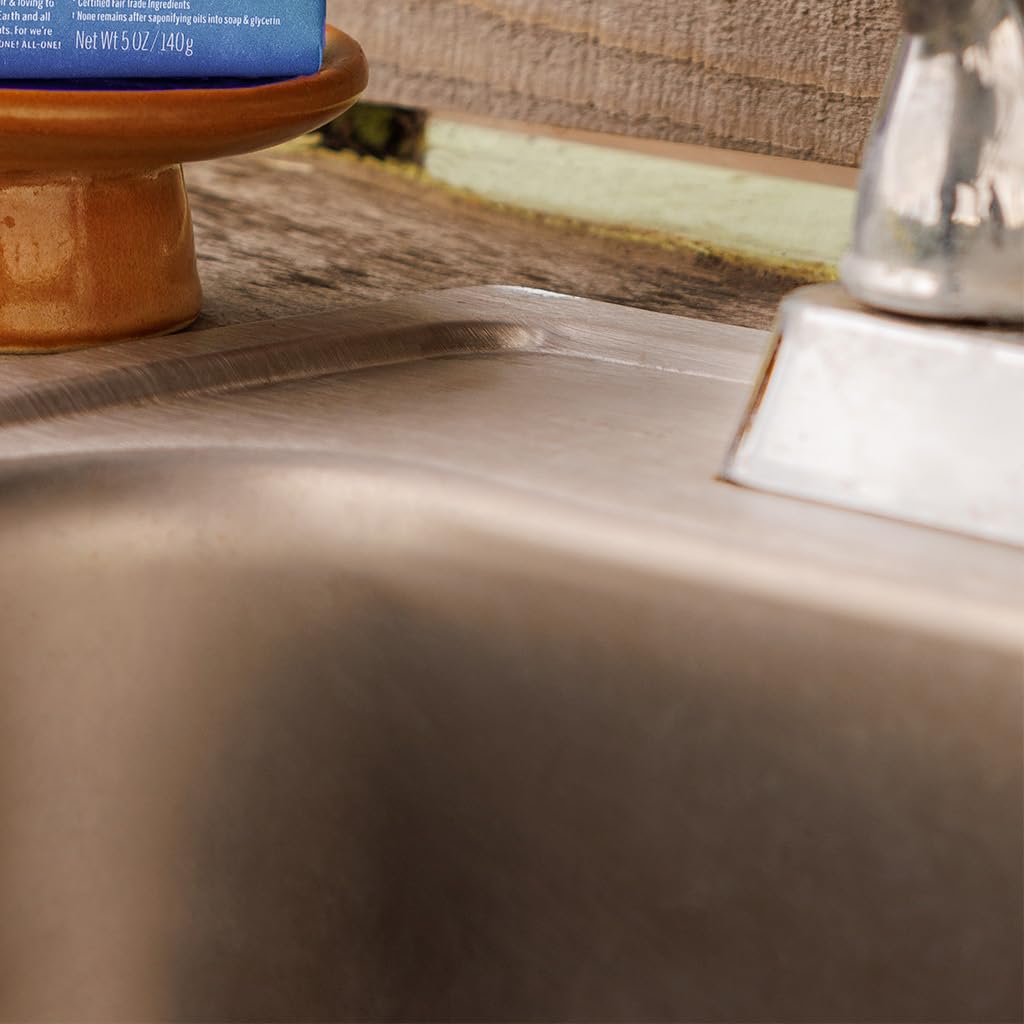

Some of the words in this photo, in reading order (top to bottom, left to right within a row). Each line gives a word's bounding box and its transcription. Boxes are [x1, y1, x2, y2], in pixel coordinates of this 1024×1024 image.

[127, 0, 147, 9] Trade
[147, 0, 191, 11] Ingredients
[22, 11, 38, 21] and
[39, 11, 51, 22] all
[77, 11, 96, 22] None
[97, 12, 127, 22] remains
[128, 13, 147, 23] after
[148, 13, 193, 26] saponifying
[193, 14, 207, 24] oils
[207, 15, 223, 24] into
[224, 16, 242, 27] soap
[243, 15, 249, 25] &
[250, 16, 281, 27] glycerin
[14, 26, 27, 35] For
[29, 25, 53, 36] we're
[21, 39, 62, 49] ALL-ONE!
[75, 30, 97, 50] Net
[101, 30, 118, 50] Wt
[121, 31, 129, 51] 5
